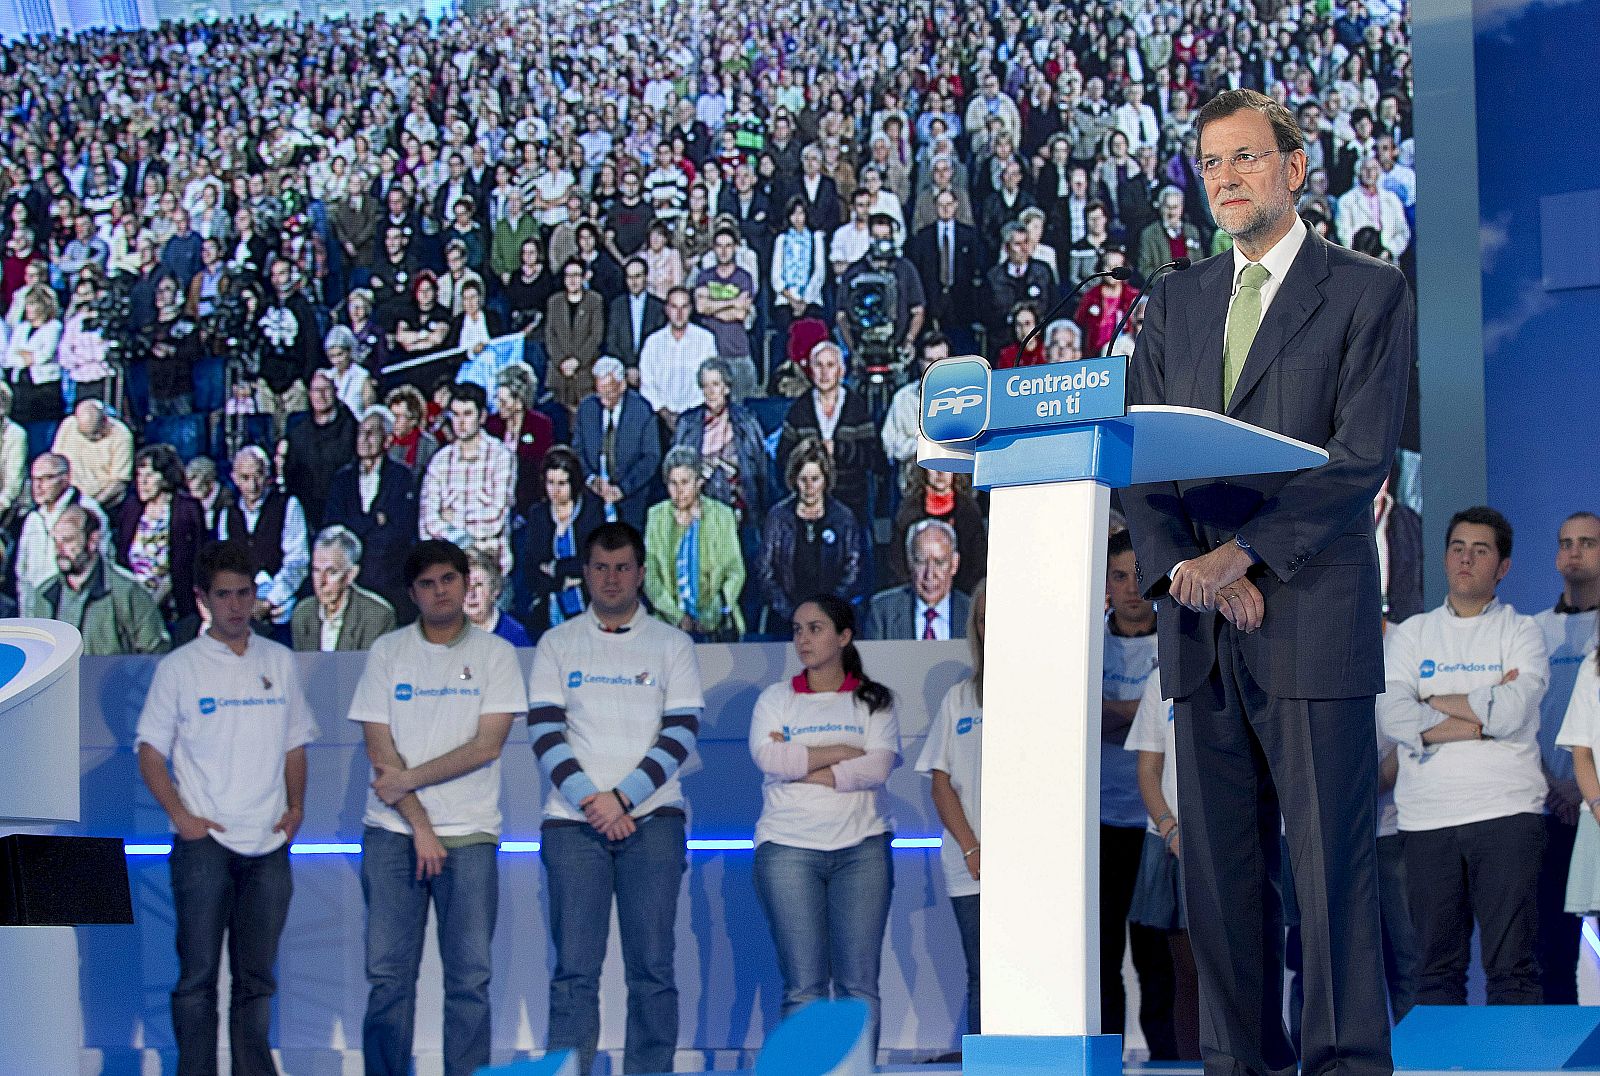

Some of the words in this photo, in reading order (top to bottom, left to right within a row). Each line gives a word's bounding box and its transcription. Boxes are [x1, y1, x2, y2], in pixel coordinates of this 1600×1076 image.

[1006, 367, 1110, 397] Centrados
[927, 394, 983, 418] PP
[1036, 399, 1062, 418] en
[1065, 392, 1081, 415] ti
[791, 723, 842, 736] Centrados
[844, 724, 857, 733] en
